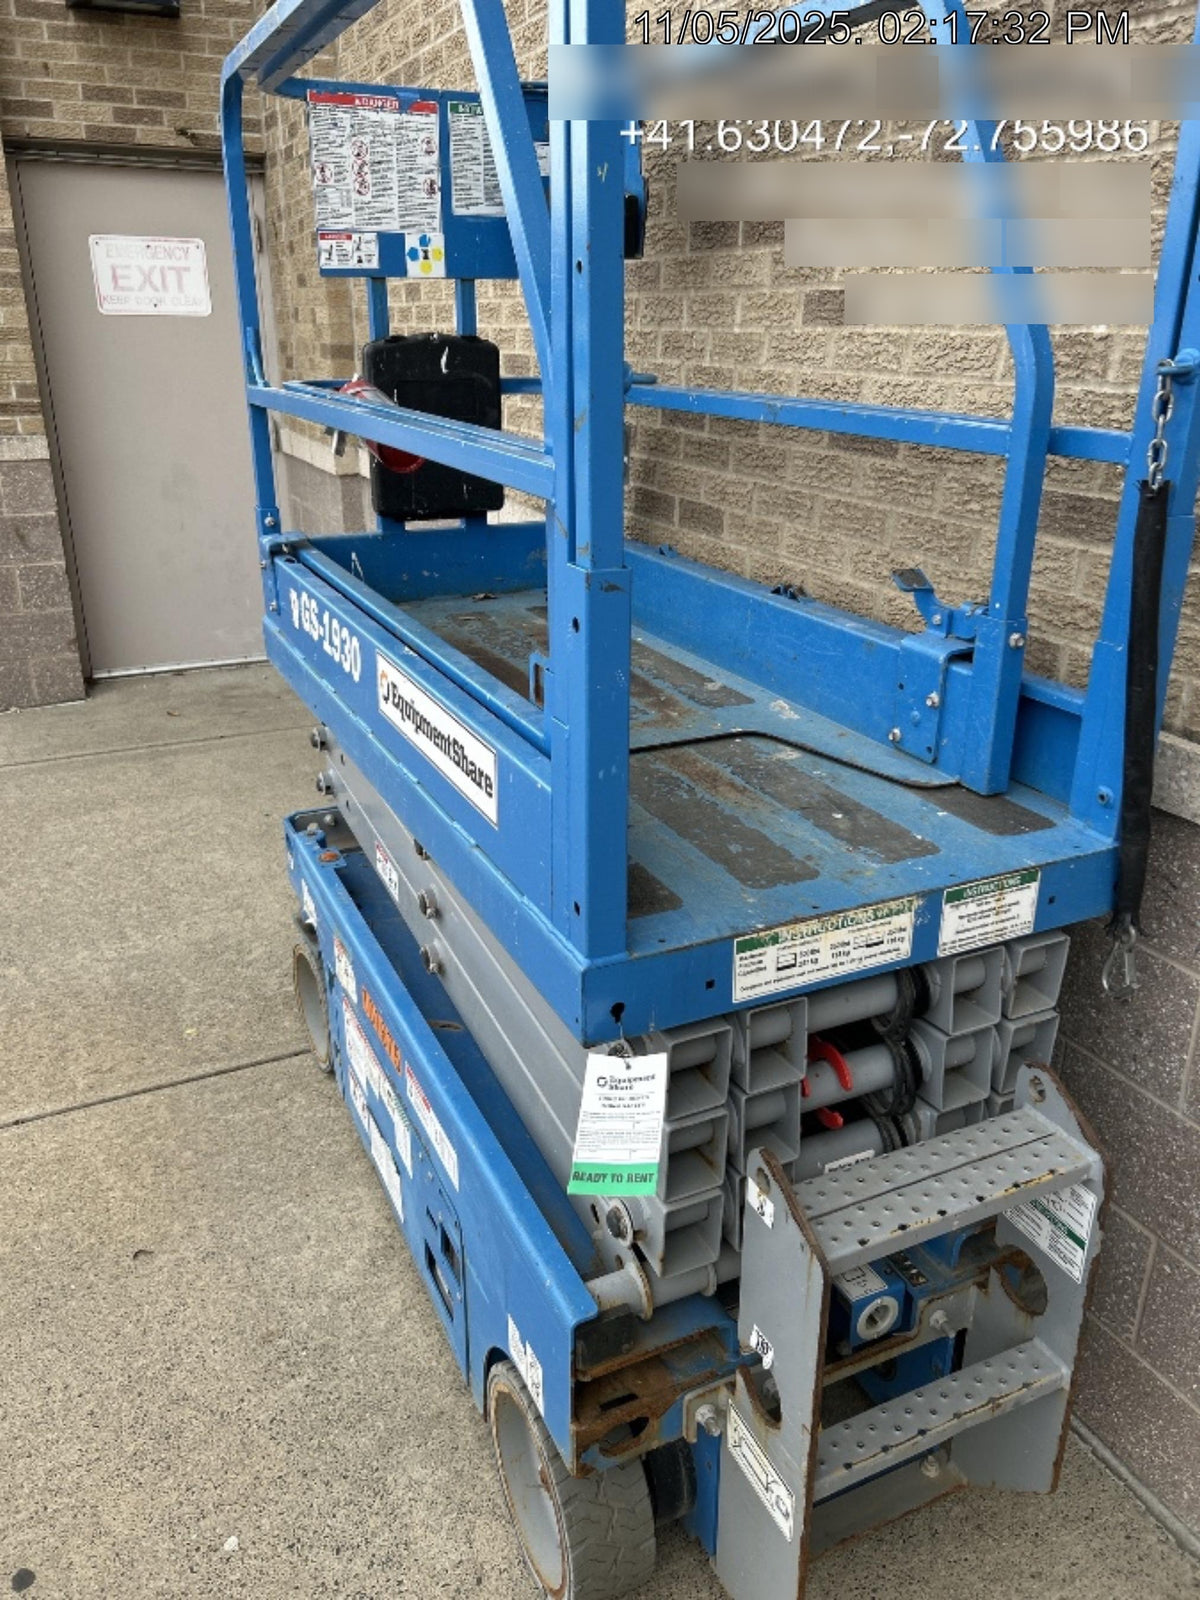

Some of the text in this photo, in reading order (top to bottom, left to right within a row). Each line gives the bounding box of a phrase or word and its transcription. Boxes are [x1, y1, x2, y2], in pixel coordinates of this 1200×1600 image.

[110, 265, 191, 293] EXIT
[103, 295, 131, 305] KEEP
[301, 591, 361, 683] GS-1930
[390, 681, 493, 799] EquipmentShare
[572, 1171, 655, 1184] READY TO RENT
